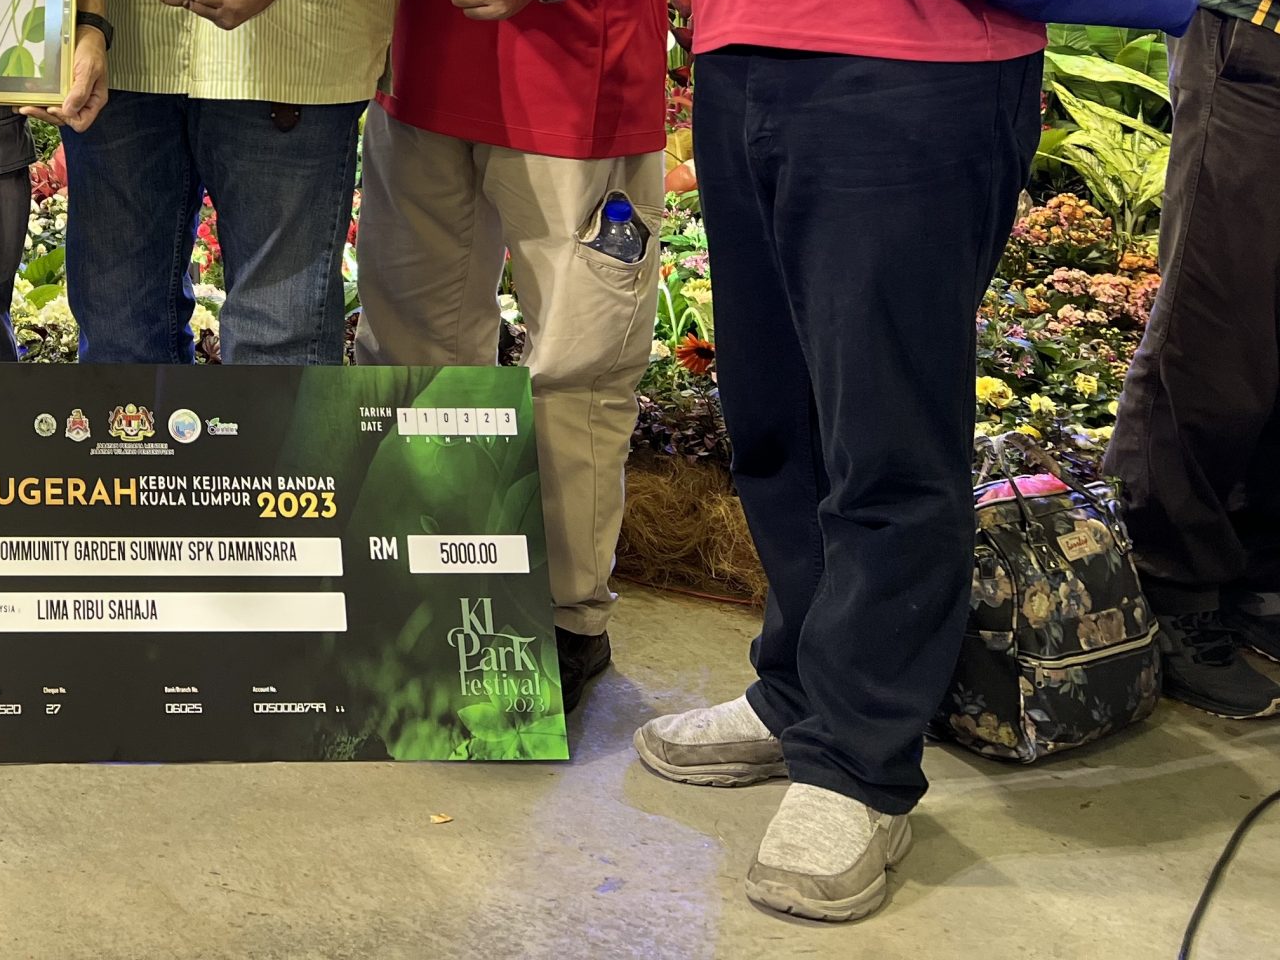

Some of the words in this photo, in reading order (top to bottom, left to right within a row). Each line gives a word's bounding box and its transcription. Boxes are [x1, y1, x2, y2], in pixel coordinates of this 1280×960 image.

[360, 407, 392, 417] TARIKH
[361, 421, 383, 432] DATE
[139, 475, 187, 490] KEBUN
[193, 476, 272, 491] KEJIRANAN
[277, 476, 335, 491] BANDAR
[139, 491, 187, 506] KUALA
[192, 491, 251, 506] LUMPUR
[256, 491, 337, 519] 2023
[74, 541, 125, 561] GARDEN
[130, 541, 183, 561] SUNWAY
[188, 541, 213, 561] SPK
[219, 541, 297, 562] DAMANSARA
[369, 537, 399, 560] RM
[440, 542, 498, 565] 5000.00
[37, 600, 69, 621] LIMA
[73, 600, 104, 621] RIBU
[108, 600, 158, 621] SAHAJA
[460, 670, 542, 696] Festival
[45, 704, 61, 714] 27
[165, 703, 202, 713] 06025
[253, 703, 327, 713] 0050008799
[504, 696, 545, 713] 2023
